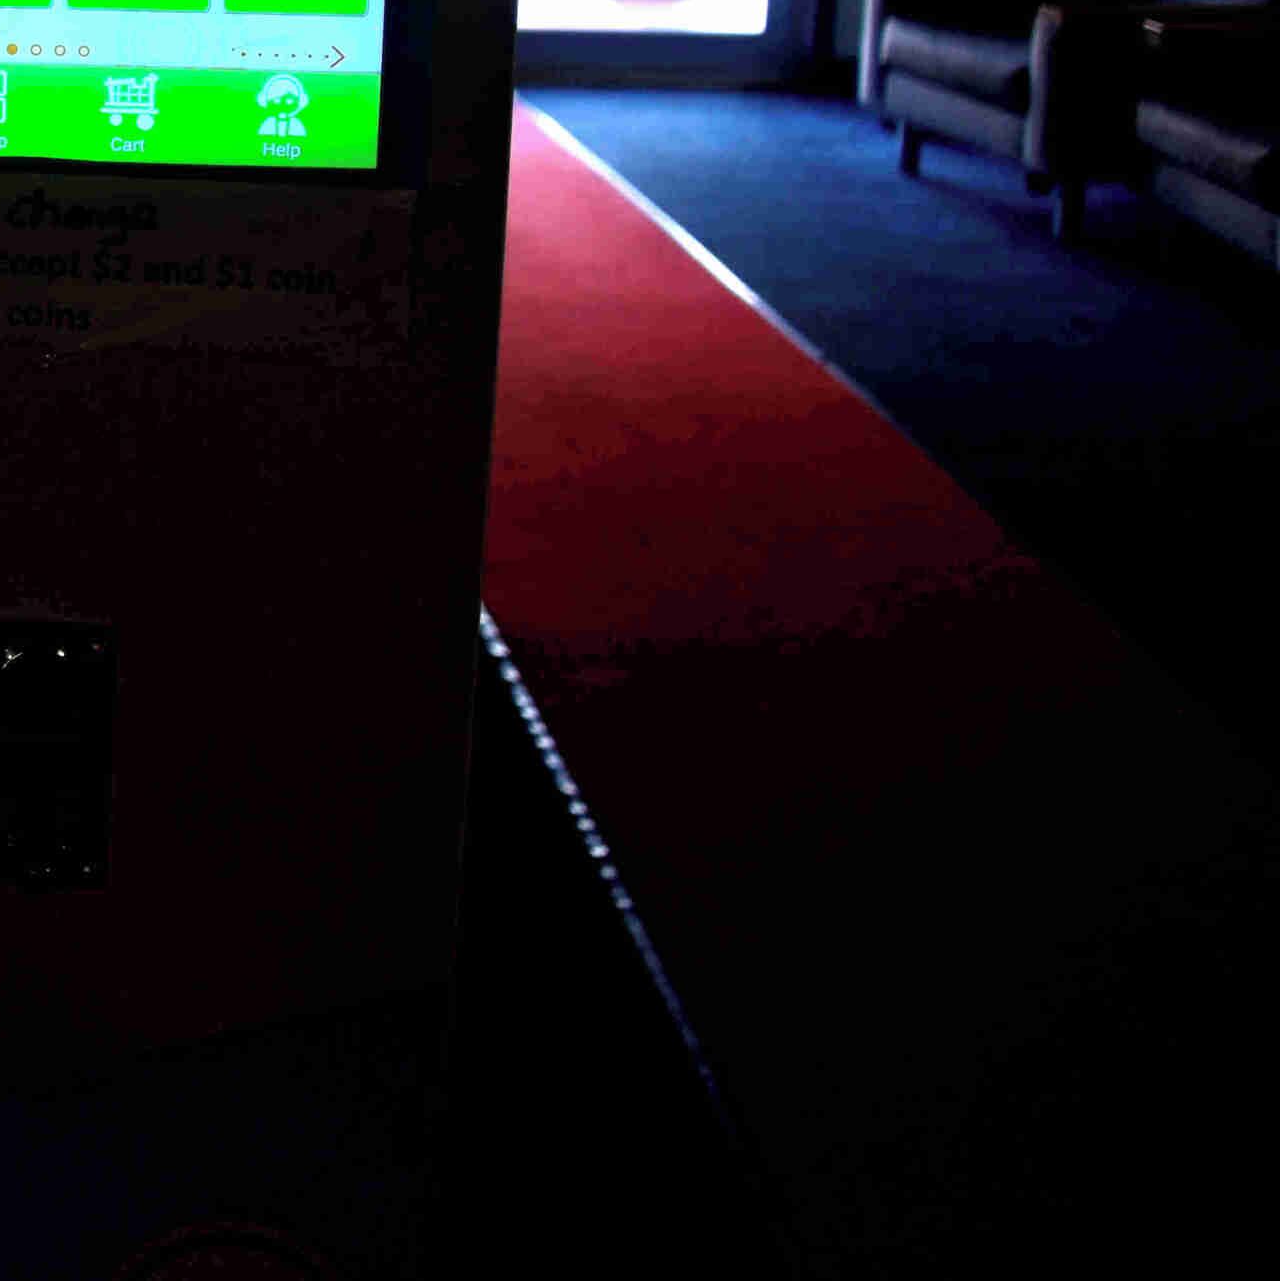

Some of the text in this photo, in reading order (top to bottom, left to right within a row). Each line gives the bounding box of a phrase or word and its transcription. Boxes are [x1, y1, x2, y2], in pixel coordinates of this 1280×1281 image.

[110, 136, 145, 153] Cart
[261, 142, 302, 161] Help
[91, 246, 132, 283] $2
[144, 256, 208, 286] and
